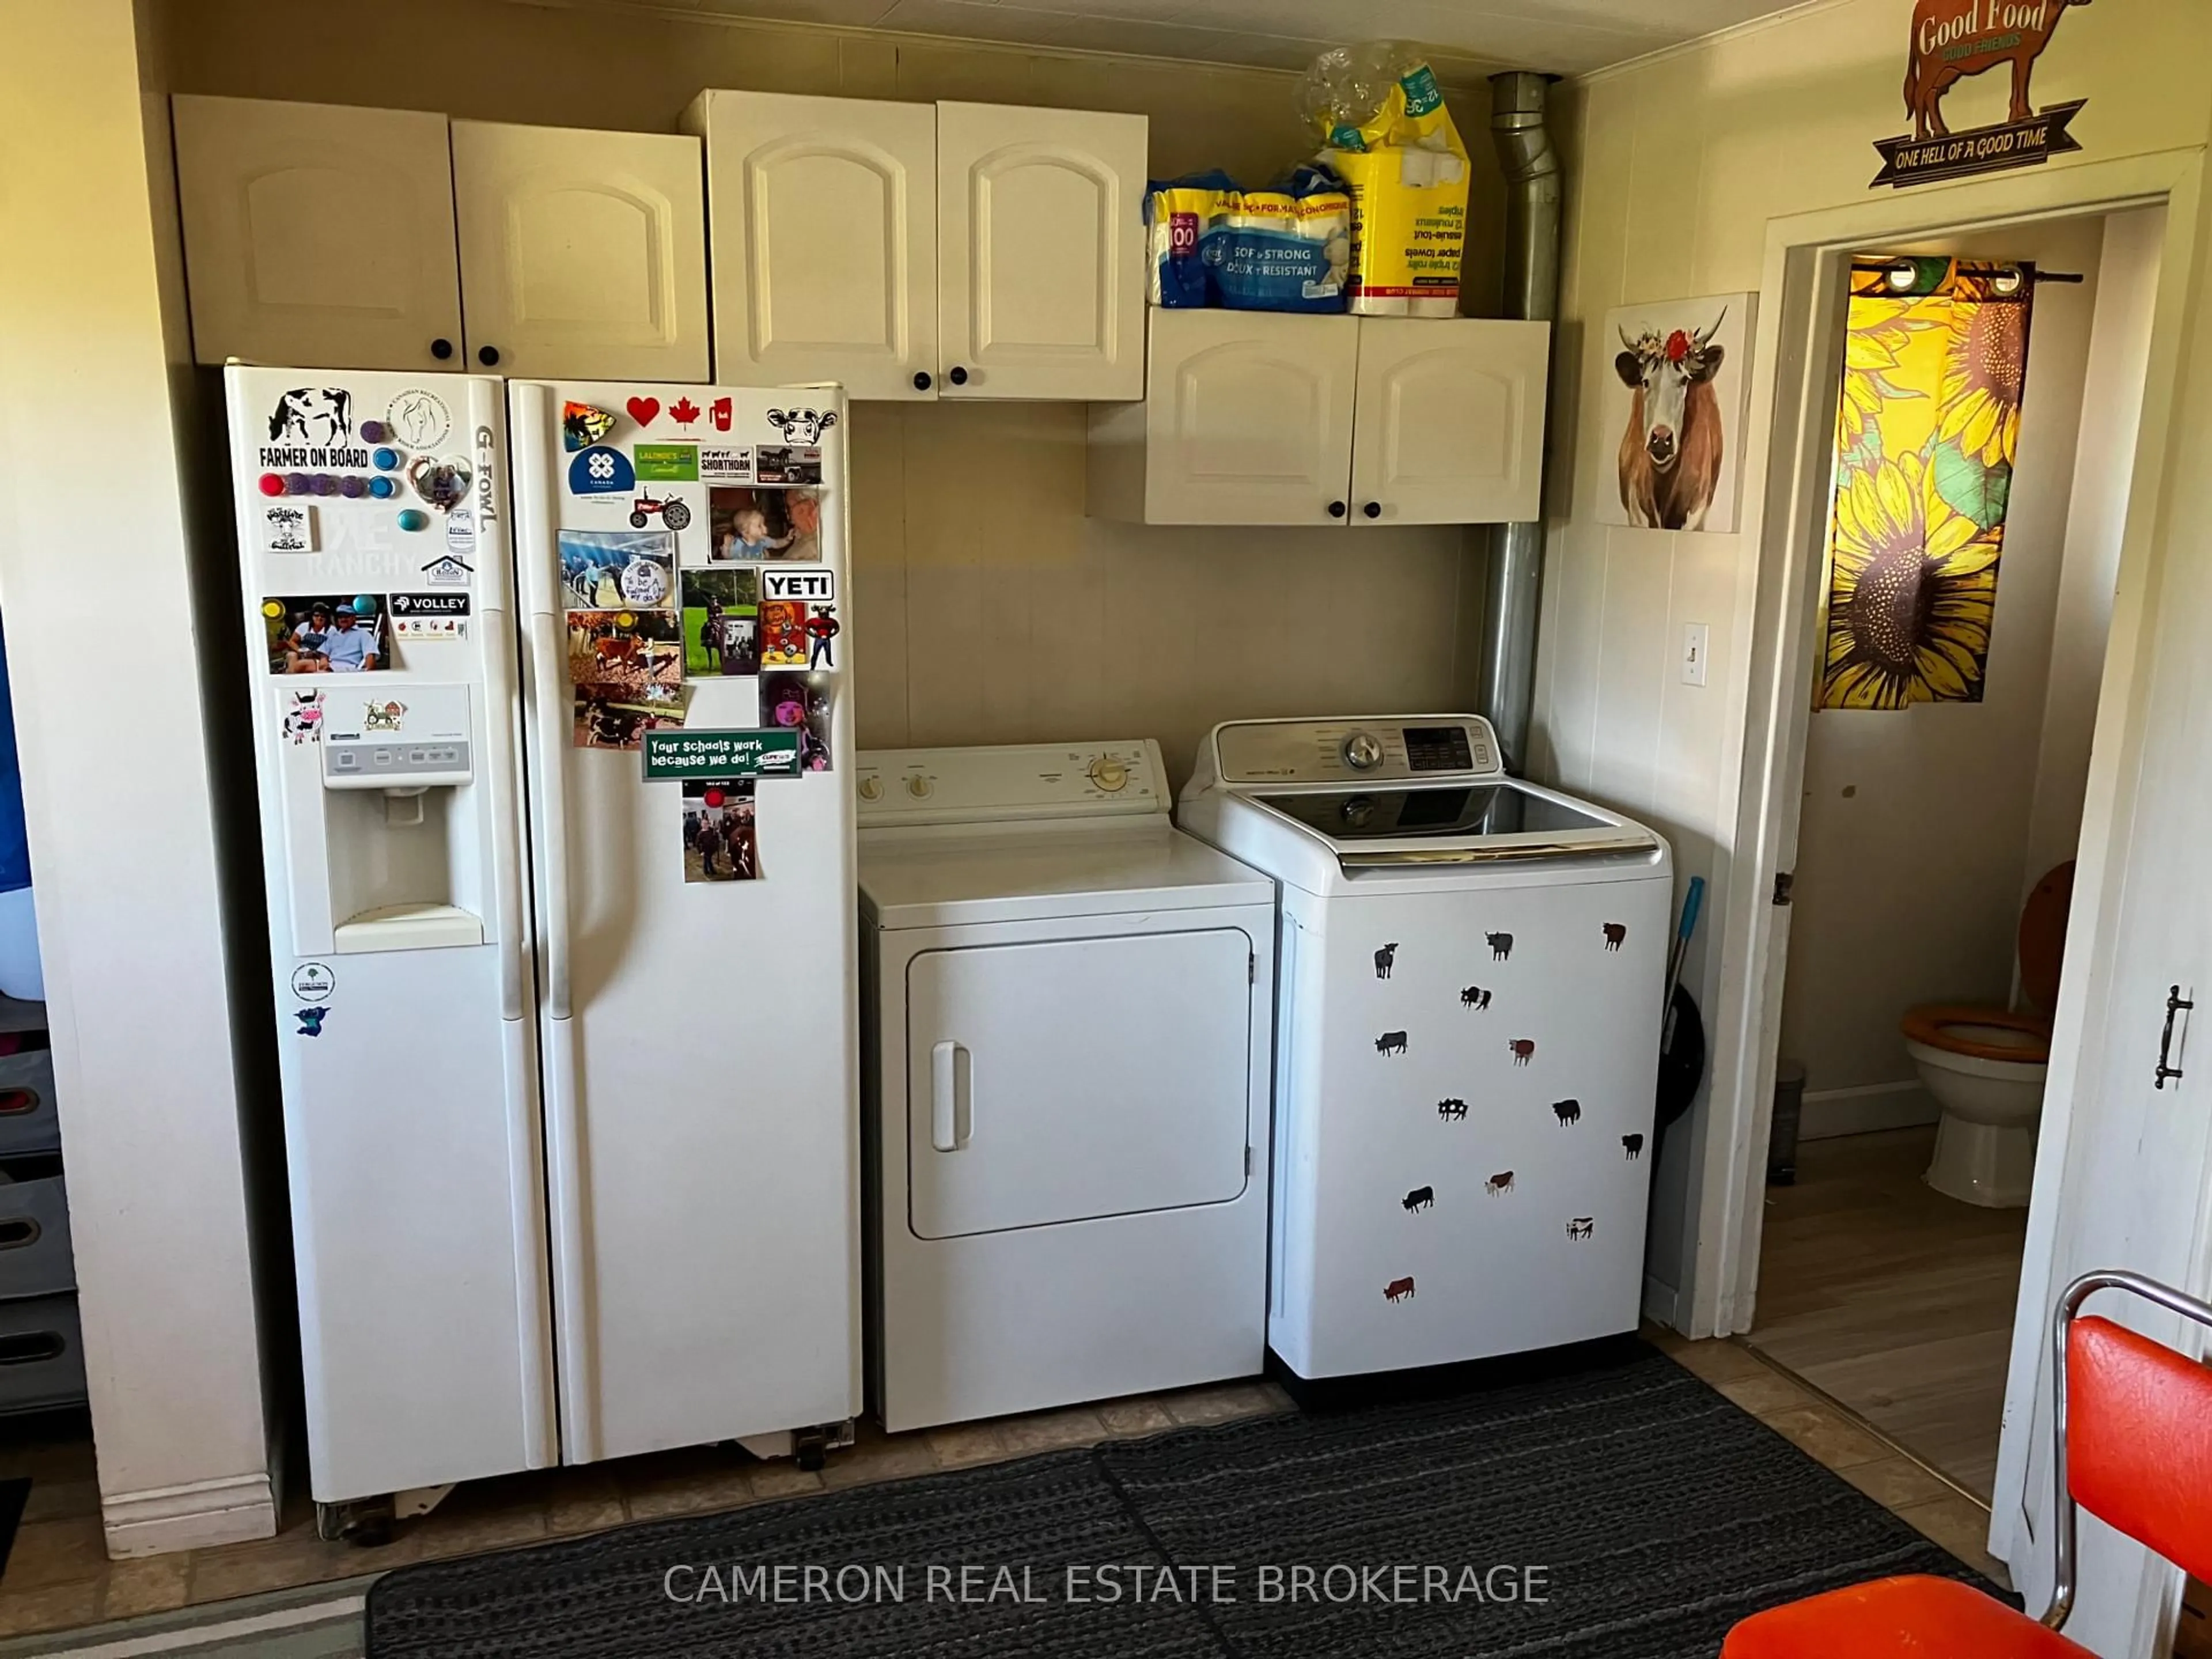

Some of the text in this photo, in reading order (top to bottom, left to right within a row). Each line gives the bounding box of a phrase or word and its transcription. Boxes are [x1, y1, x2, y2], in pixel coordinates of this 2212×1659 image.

[1919, 0, 2047, 55] Good Food
[1942, 32, 2022, 61] GOOD FRIENDS
[1896, 126, 2048, 169] ONE HELL OF A GOOD TIME
[1414, 230, 1462, 241] essuie-tout
[1264, 248, 1311, 260] STRONG
[1405, 248, 1461, 259] paper towels
[260, 448, 368, 468] FARMER ON BOARD
[701, 460, 751, 471] SHORTHORN
[476, 425, 498, 533] G-FOWL
[768, 577, 827, 595] YETI
[413, 599, 465, 609] VOLLEY
[652, 740, 762, 753] Your schools work
[652, 753, 749, 767] because we do!
